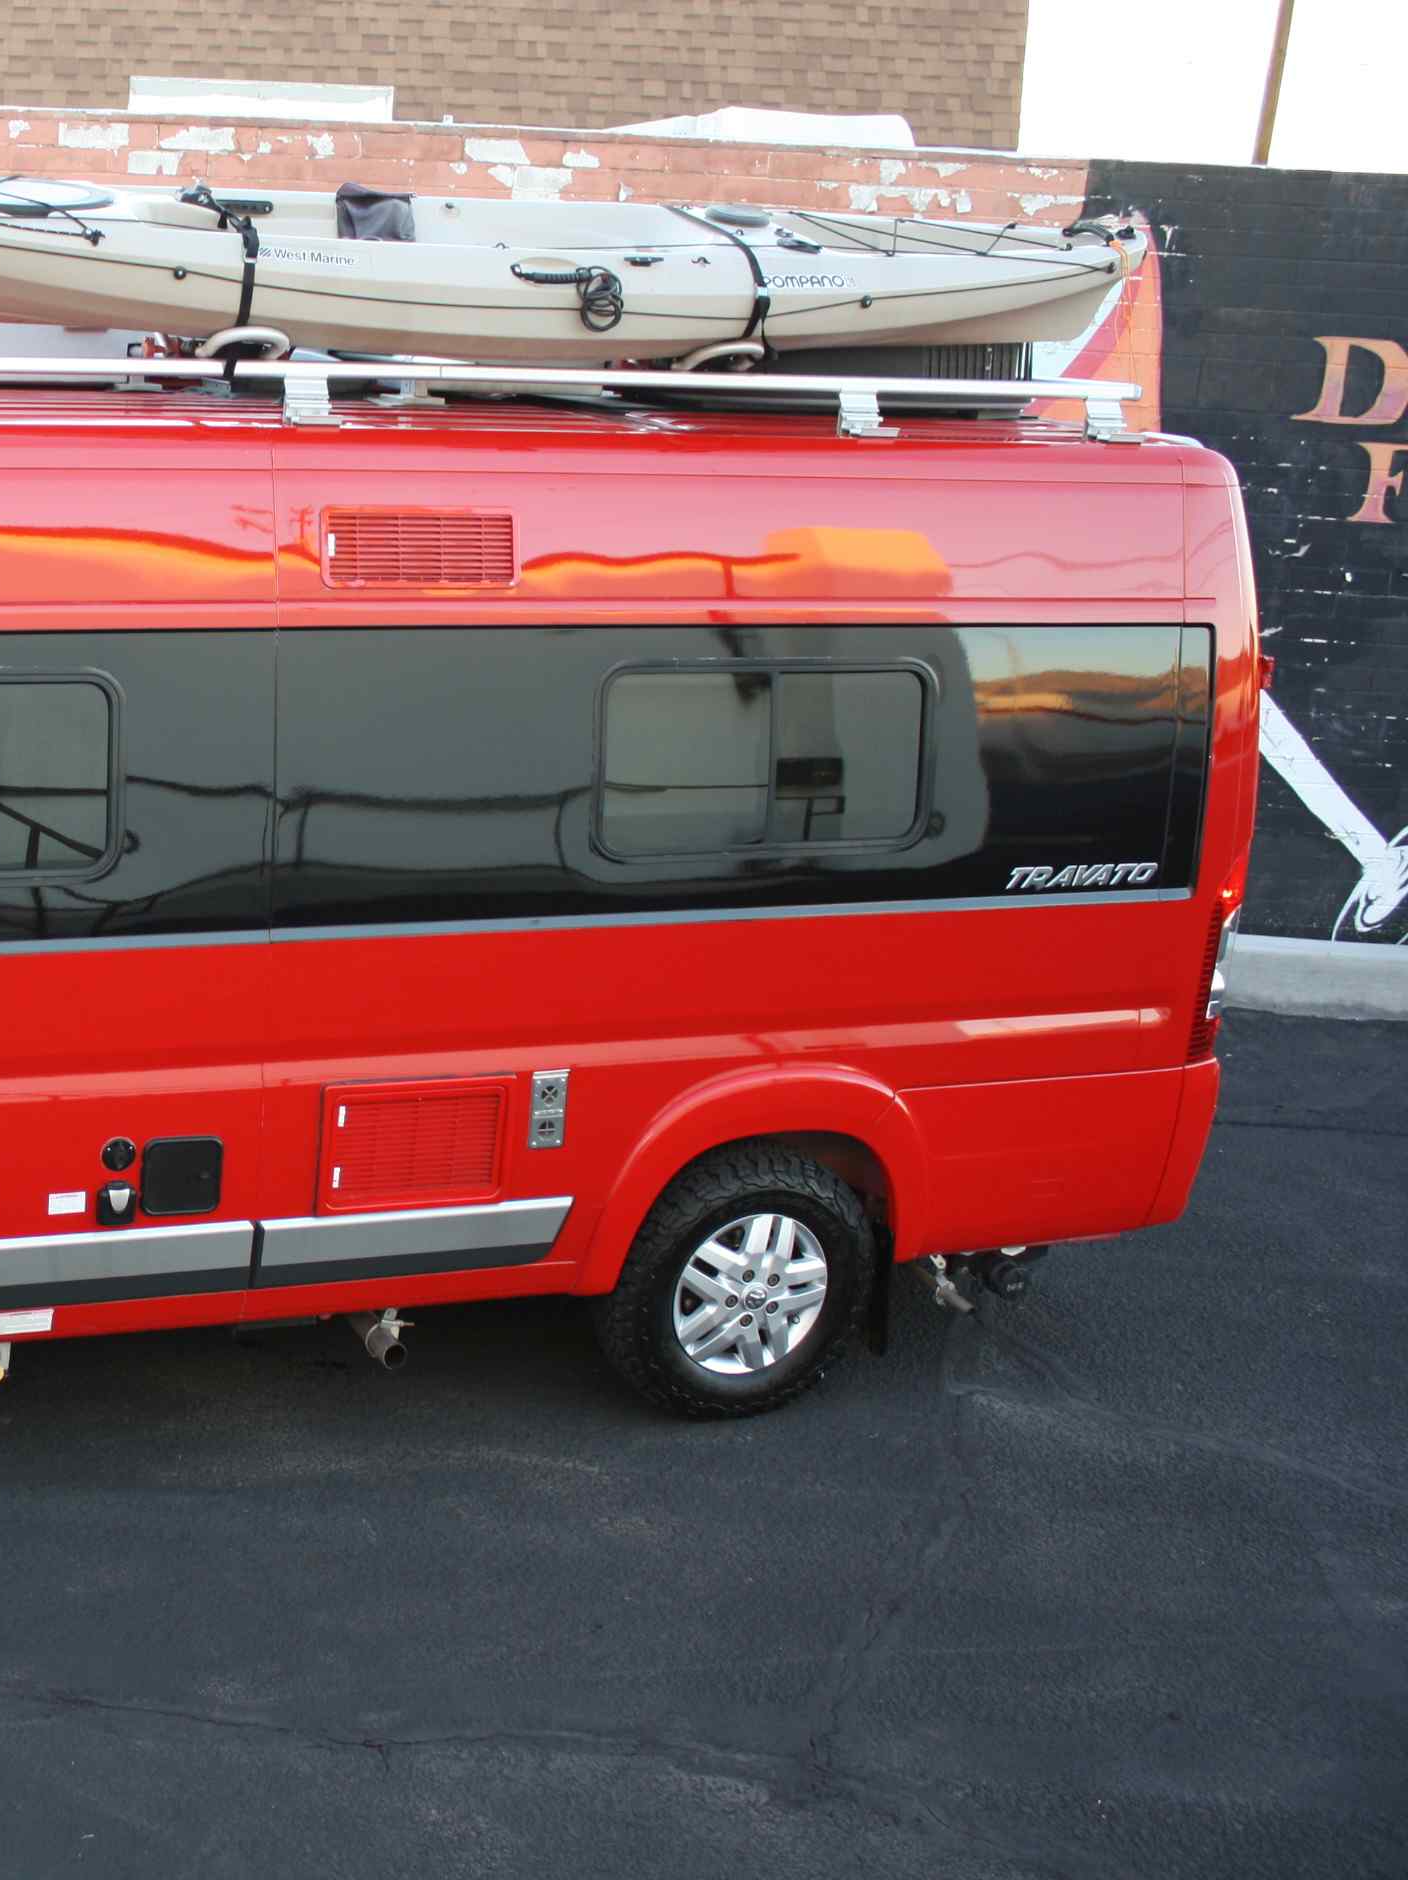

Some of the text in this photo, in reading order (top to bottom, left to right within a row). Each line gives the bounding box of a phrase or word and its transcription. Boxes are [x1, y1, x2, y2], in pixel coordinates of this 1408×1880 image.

[274, 248, 355, 265] West Marine
[1006, 862, 1158, 890] TRAVATO
